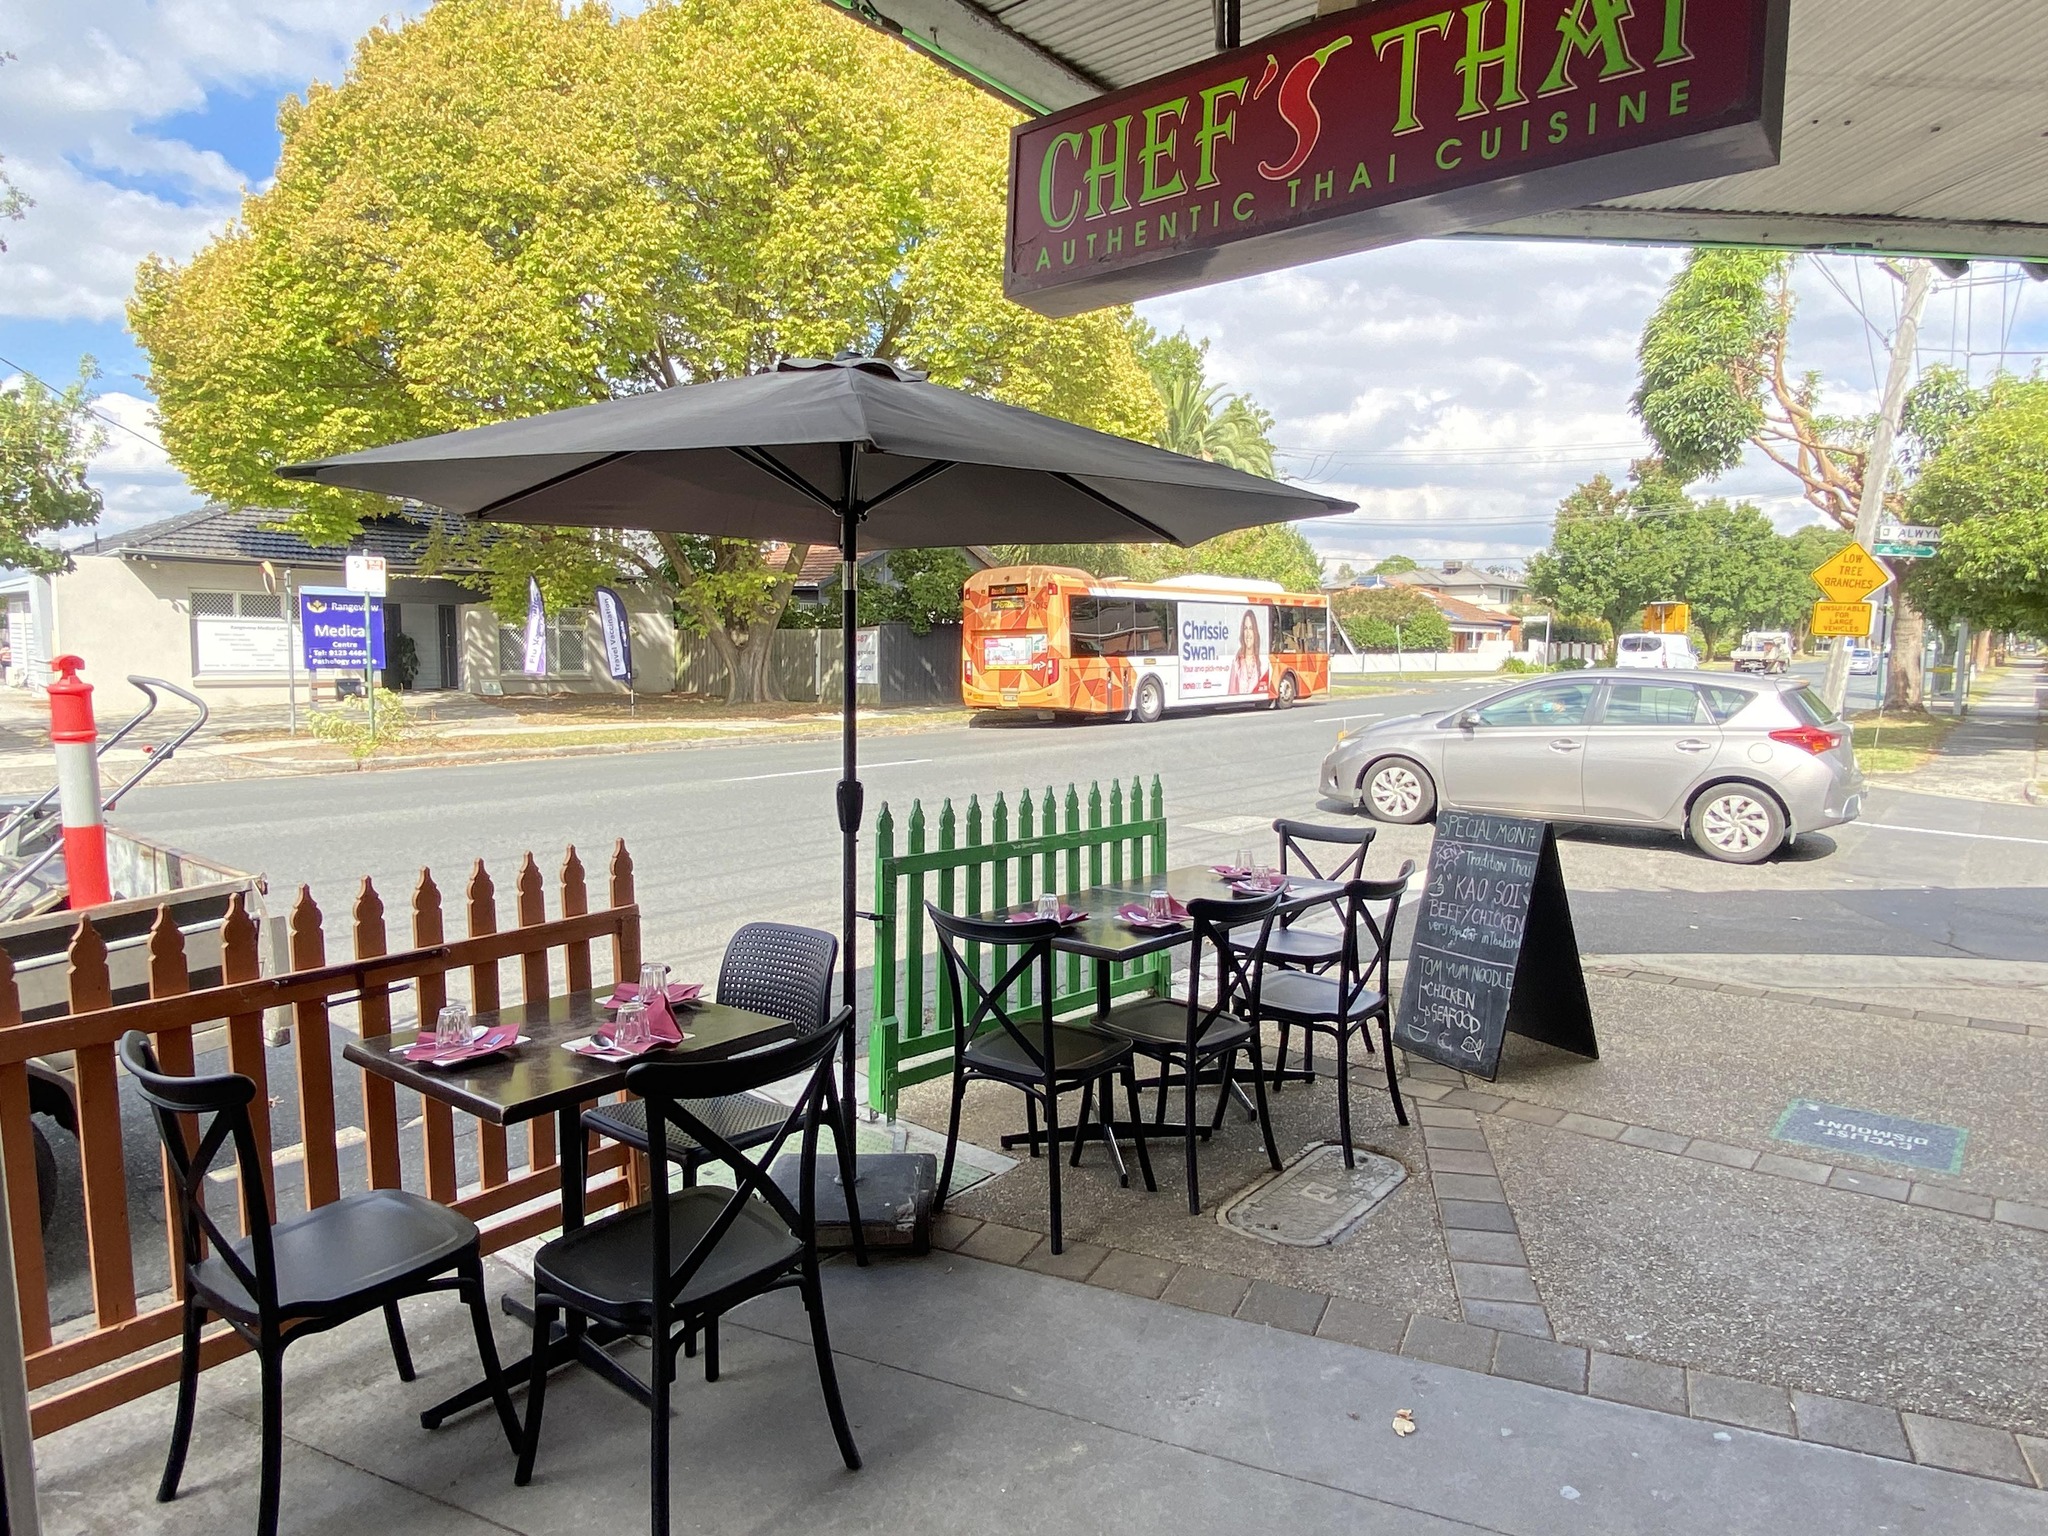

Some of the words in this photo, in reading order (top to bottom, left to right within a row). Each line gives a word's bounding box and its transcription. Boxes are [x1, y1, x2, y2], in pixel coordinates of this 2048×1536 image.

[1038, 35, 1353, 232] CHEF'S
[1371, 0, 1696, 137] THAI
[1035, 194, 1256, 270] AUTHENTIC
[1287, 154, 1397, 207] THAI
[1435, 79, 1693, 170] CUISINE
[1843, 553, 1864, 564] LOW
[1840, 565, 1864, 577] TREE
[1824, 577, 1873, 589] BRANCHES
[314, 624, 366, 638] Medica
[604, 598, 617, 645] Vaccination
[1182, 620, 1229, 640] Chrissie
[312, 658, 350, 666] Pathology
[611, 647, 621, 672] Travel
[1182, 642, 1219, 661] Swan.
[1440, 815, 1491, 841] SPECIAL
[1510, 858, 1533, 877] Thai
[1428, 921, 1448, 936] very
[1419, 955, 1442, 981] TOM
[1446, 961, 1469, 979] YUM
[1426, 981, 1476, 1010] CHICKEN
[1431, 1003, 1480, 1034] SEAFOOD
[1814, 1118, 1929, 1146] DISMOUNT
[1822, 1128, 1912, 1151] CYCLIST
